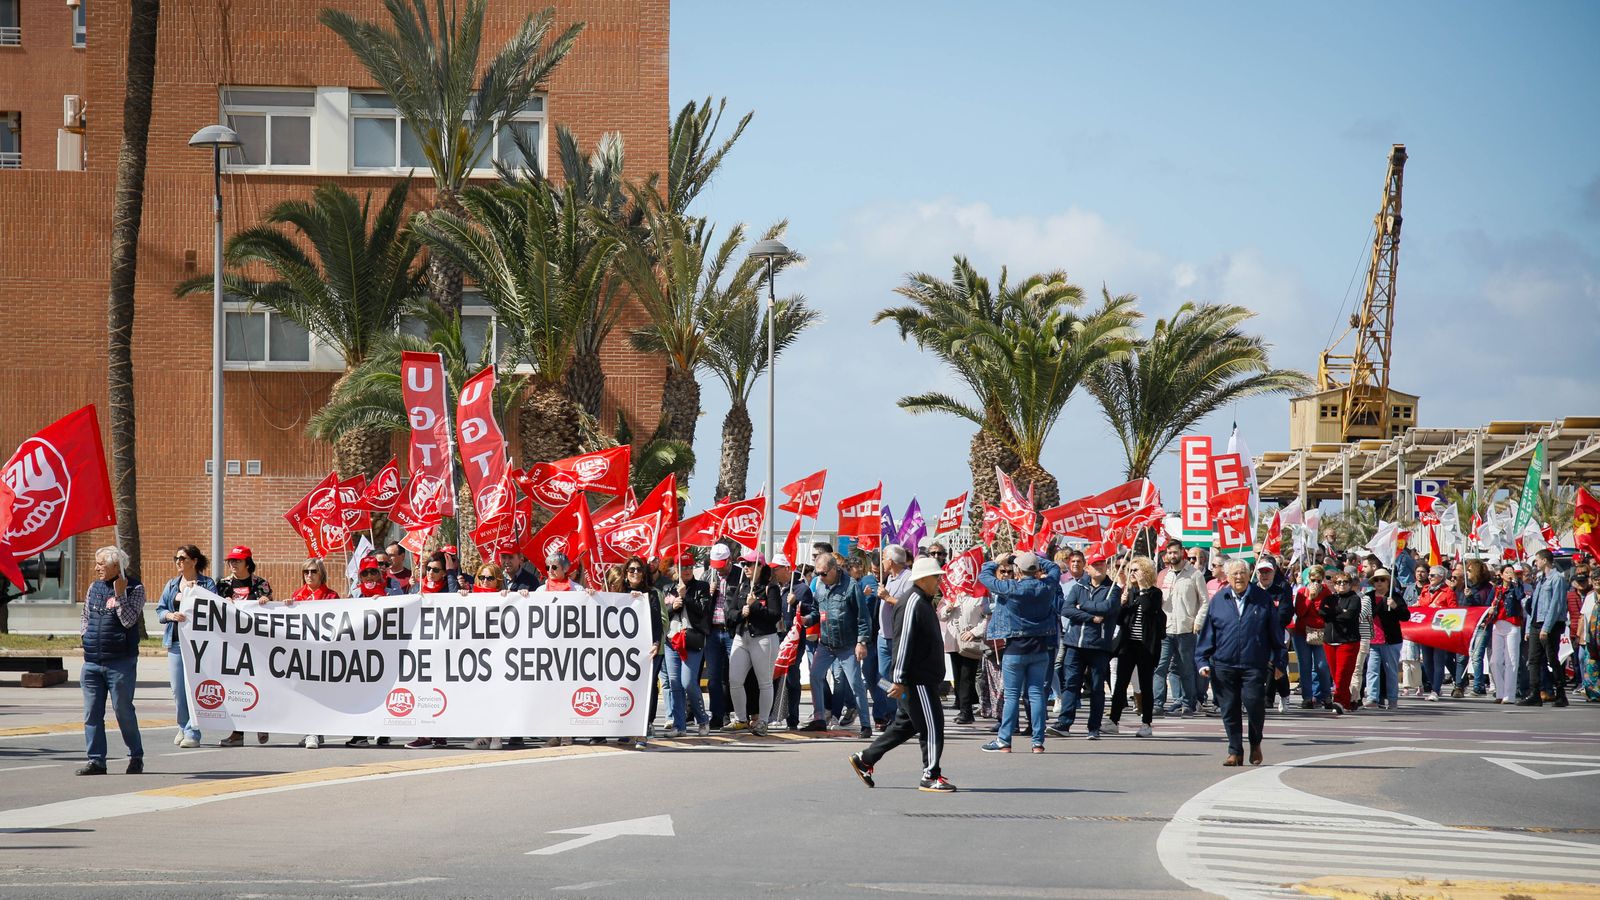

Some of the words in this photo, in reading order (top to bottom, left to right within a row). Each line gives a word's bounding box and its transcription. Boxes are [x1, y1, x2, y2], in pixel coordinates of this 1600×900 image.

[1186, 440, 1207, 527] CCOO
[1214, 458, 1247, 545] CCO
[192, 598, 227, 633] EN
[235, 608, 356, 642] DEFENSA
[363, 607, 412, 641] DEL
[420, 606, 520, 640] EMPLEO
[528, 597, 639, 639] PÚBLICO
[190, 639, 209, 674] Y
[221, 641, 255, 676] LA
[269, 646, 384, 682] CALIDAD
[398, 649, 432, 682] DE
[445, 647, 492, 682] LOS
[504, 647, 641, 682] SERVICIOS
[199, 684, 222, 698] UGT
[228, 688, 254, 696] Servicios
[390, 692, 412, 704] UGT
[575, 691, 598, 704] UGT
[228, 695, 251, 703] Públicos
